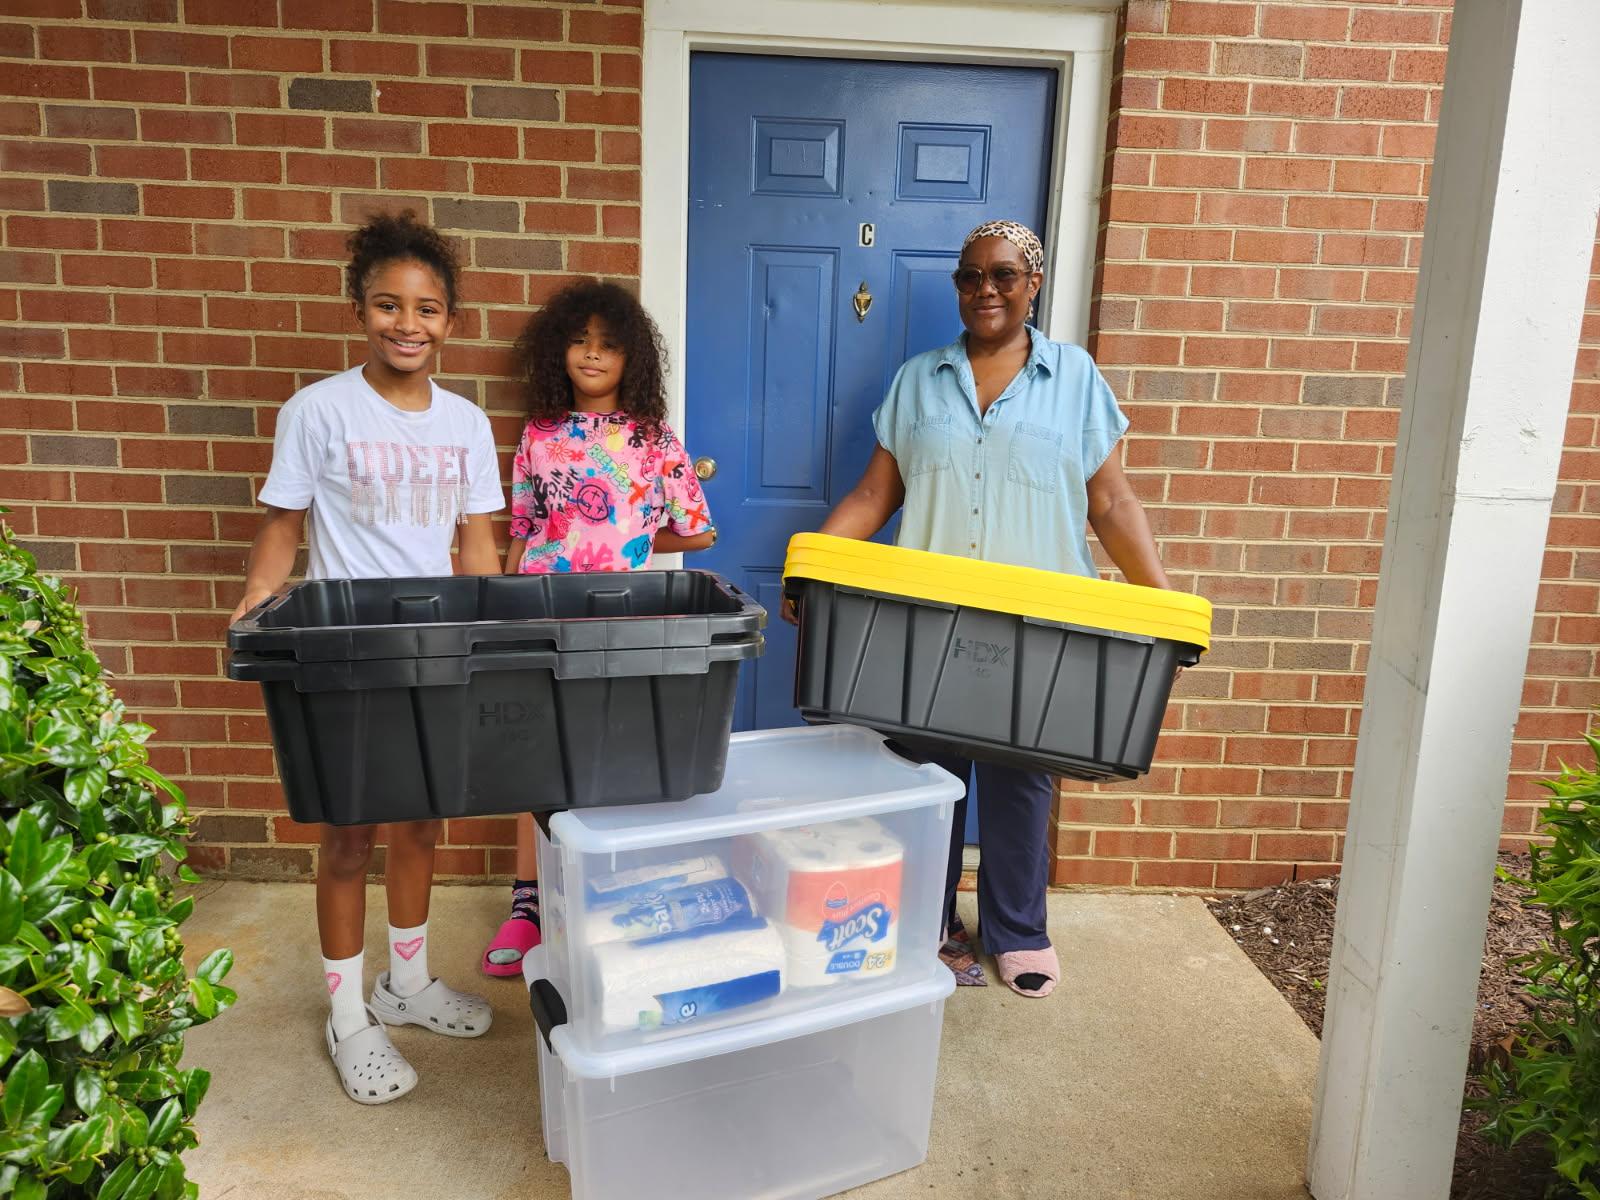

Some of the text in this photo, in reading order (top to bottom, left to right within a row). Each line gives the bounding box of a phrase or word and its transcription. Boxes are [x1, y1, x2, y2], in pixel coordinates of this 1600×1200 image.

[861, 223, 873, 246] C
[953, 637, 1010, 669] HDX
[480, 703, 545, 729] HDX
[828, 907, 884, 952] Scott
